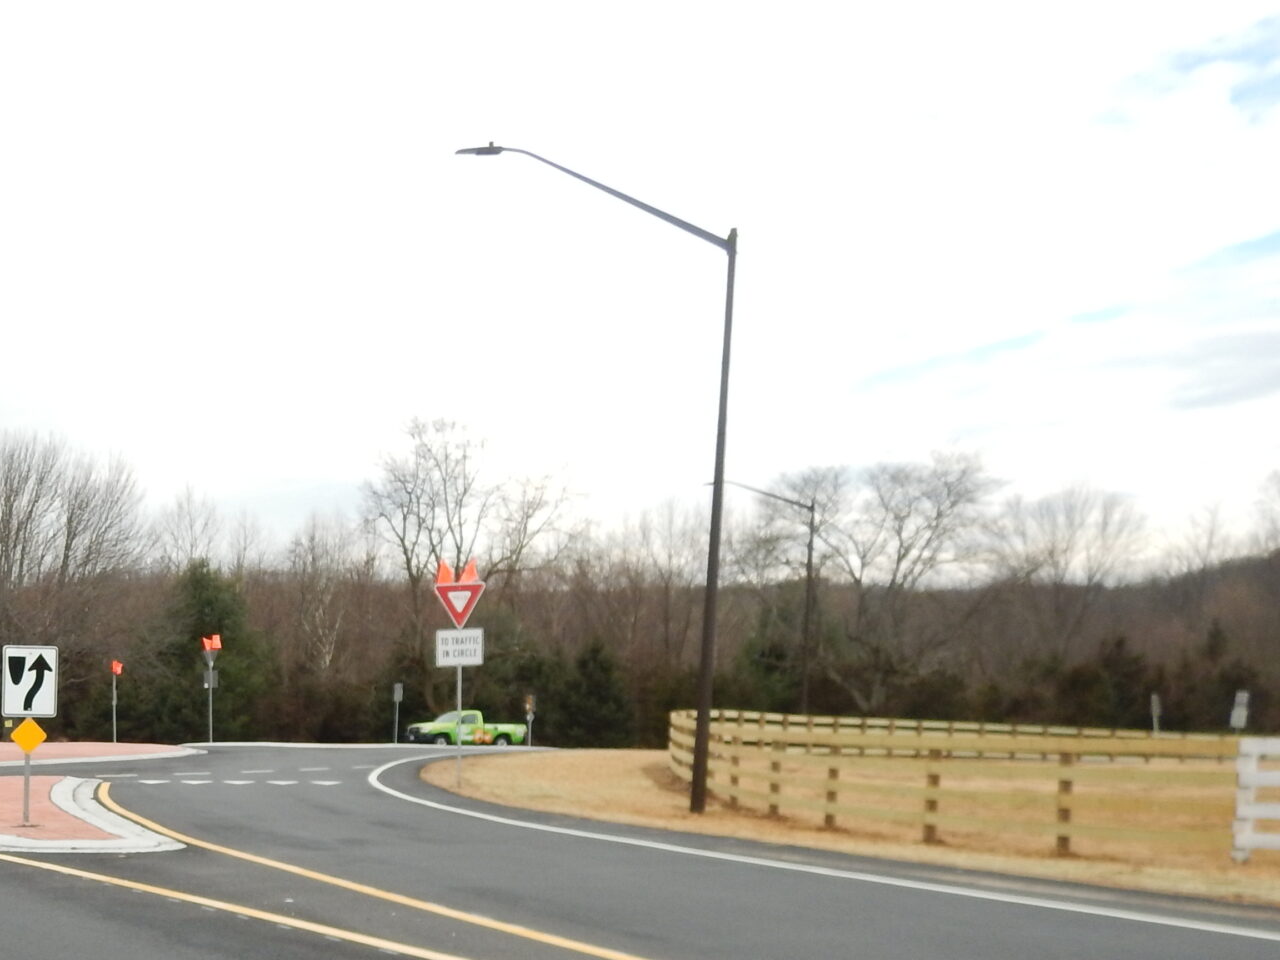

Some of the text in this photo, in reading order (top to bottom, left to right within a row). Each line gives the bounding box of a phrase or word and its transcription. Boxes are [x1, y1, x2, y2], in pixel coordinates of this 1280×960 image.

[441, 636, 481, 646] TO TRAFFIC
[453, 648, 477, 658] CIRCLE
